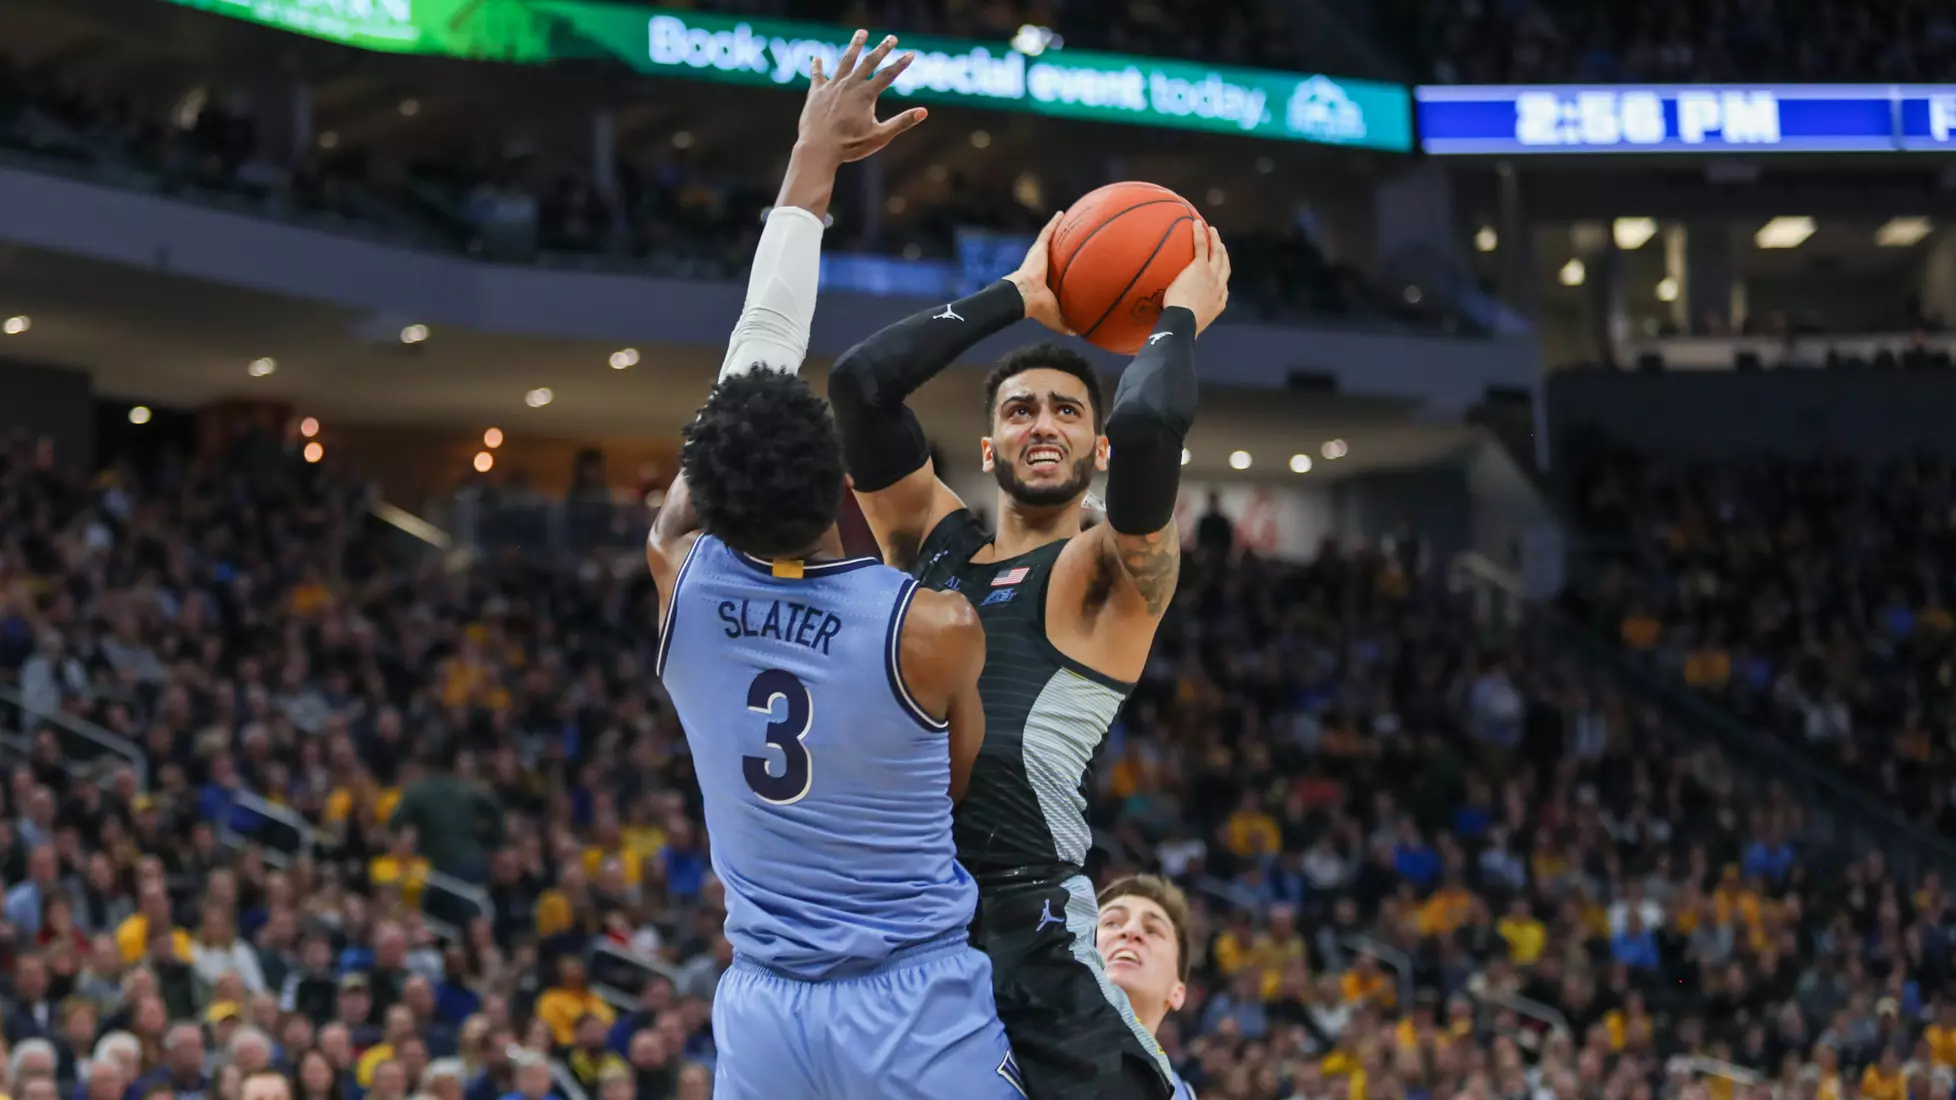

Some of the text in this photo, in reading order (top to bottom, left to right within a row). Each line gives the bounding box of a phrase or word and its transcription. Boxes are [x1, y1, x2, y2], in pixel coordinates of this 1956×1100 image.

[649, 15, 769, 74] Book
[1027, 63, 1147, 111] event
[1677, 91, 1781, 144] PM
[718, 599, 842, 656] SLATER
[742, 668, 813, 805] 3
